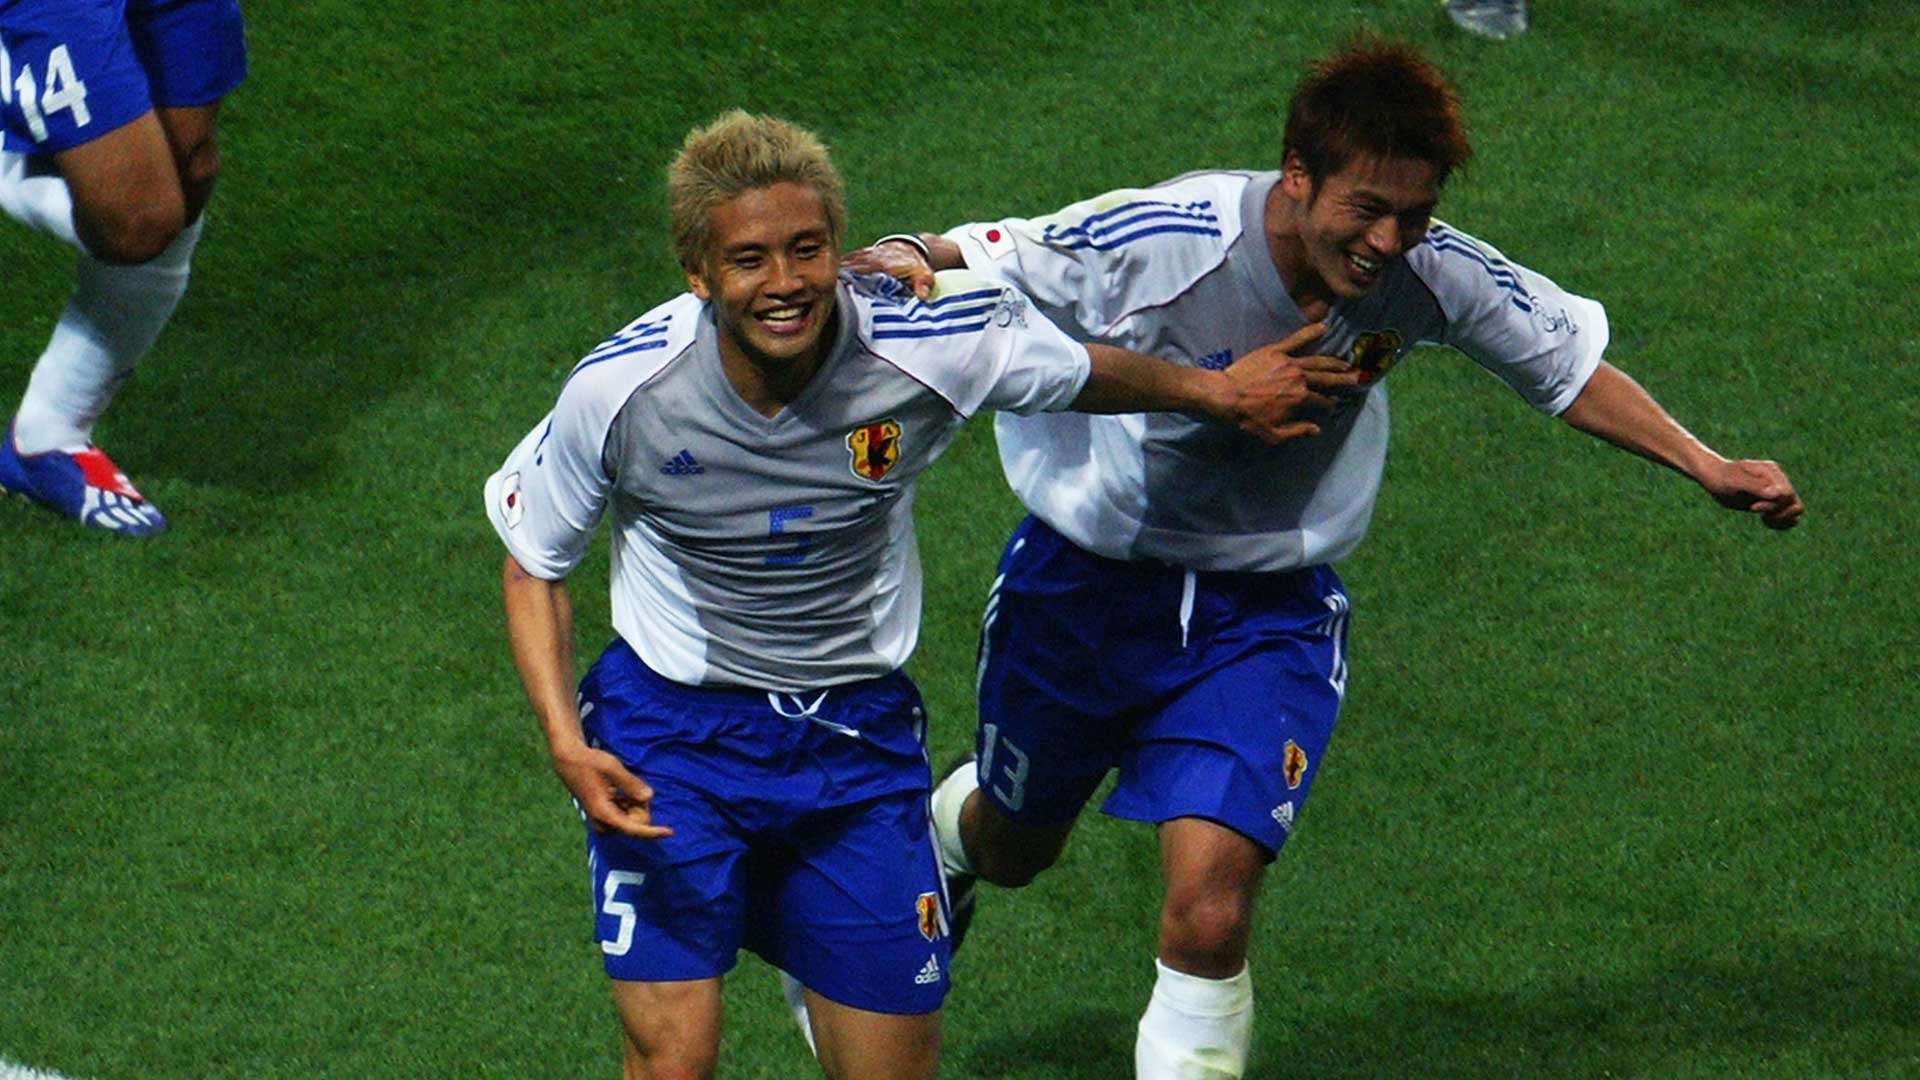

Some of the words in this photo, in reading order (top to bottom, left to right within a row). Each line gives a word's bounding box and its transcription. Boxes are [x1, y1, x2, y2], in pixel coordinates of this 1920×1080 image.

[15, 43, 91, 144] 14
[766, 505, 815, 565] 5
[980, 723, 1029, 812] 13
[601, 869, 646, 956] 5
